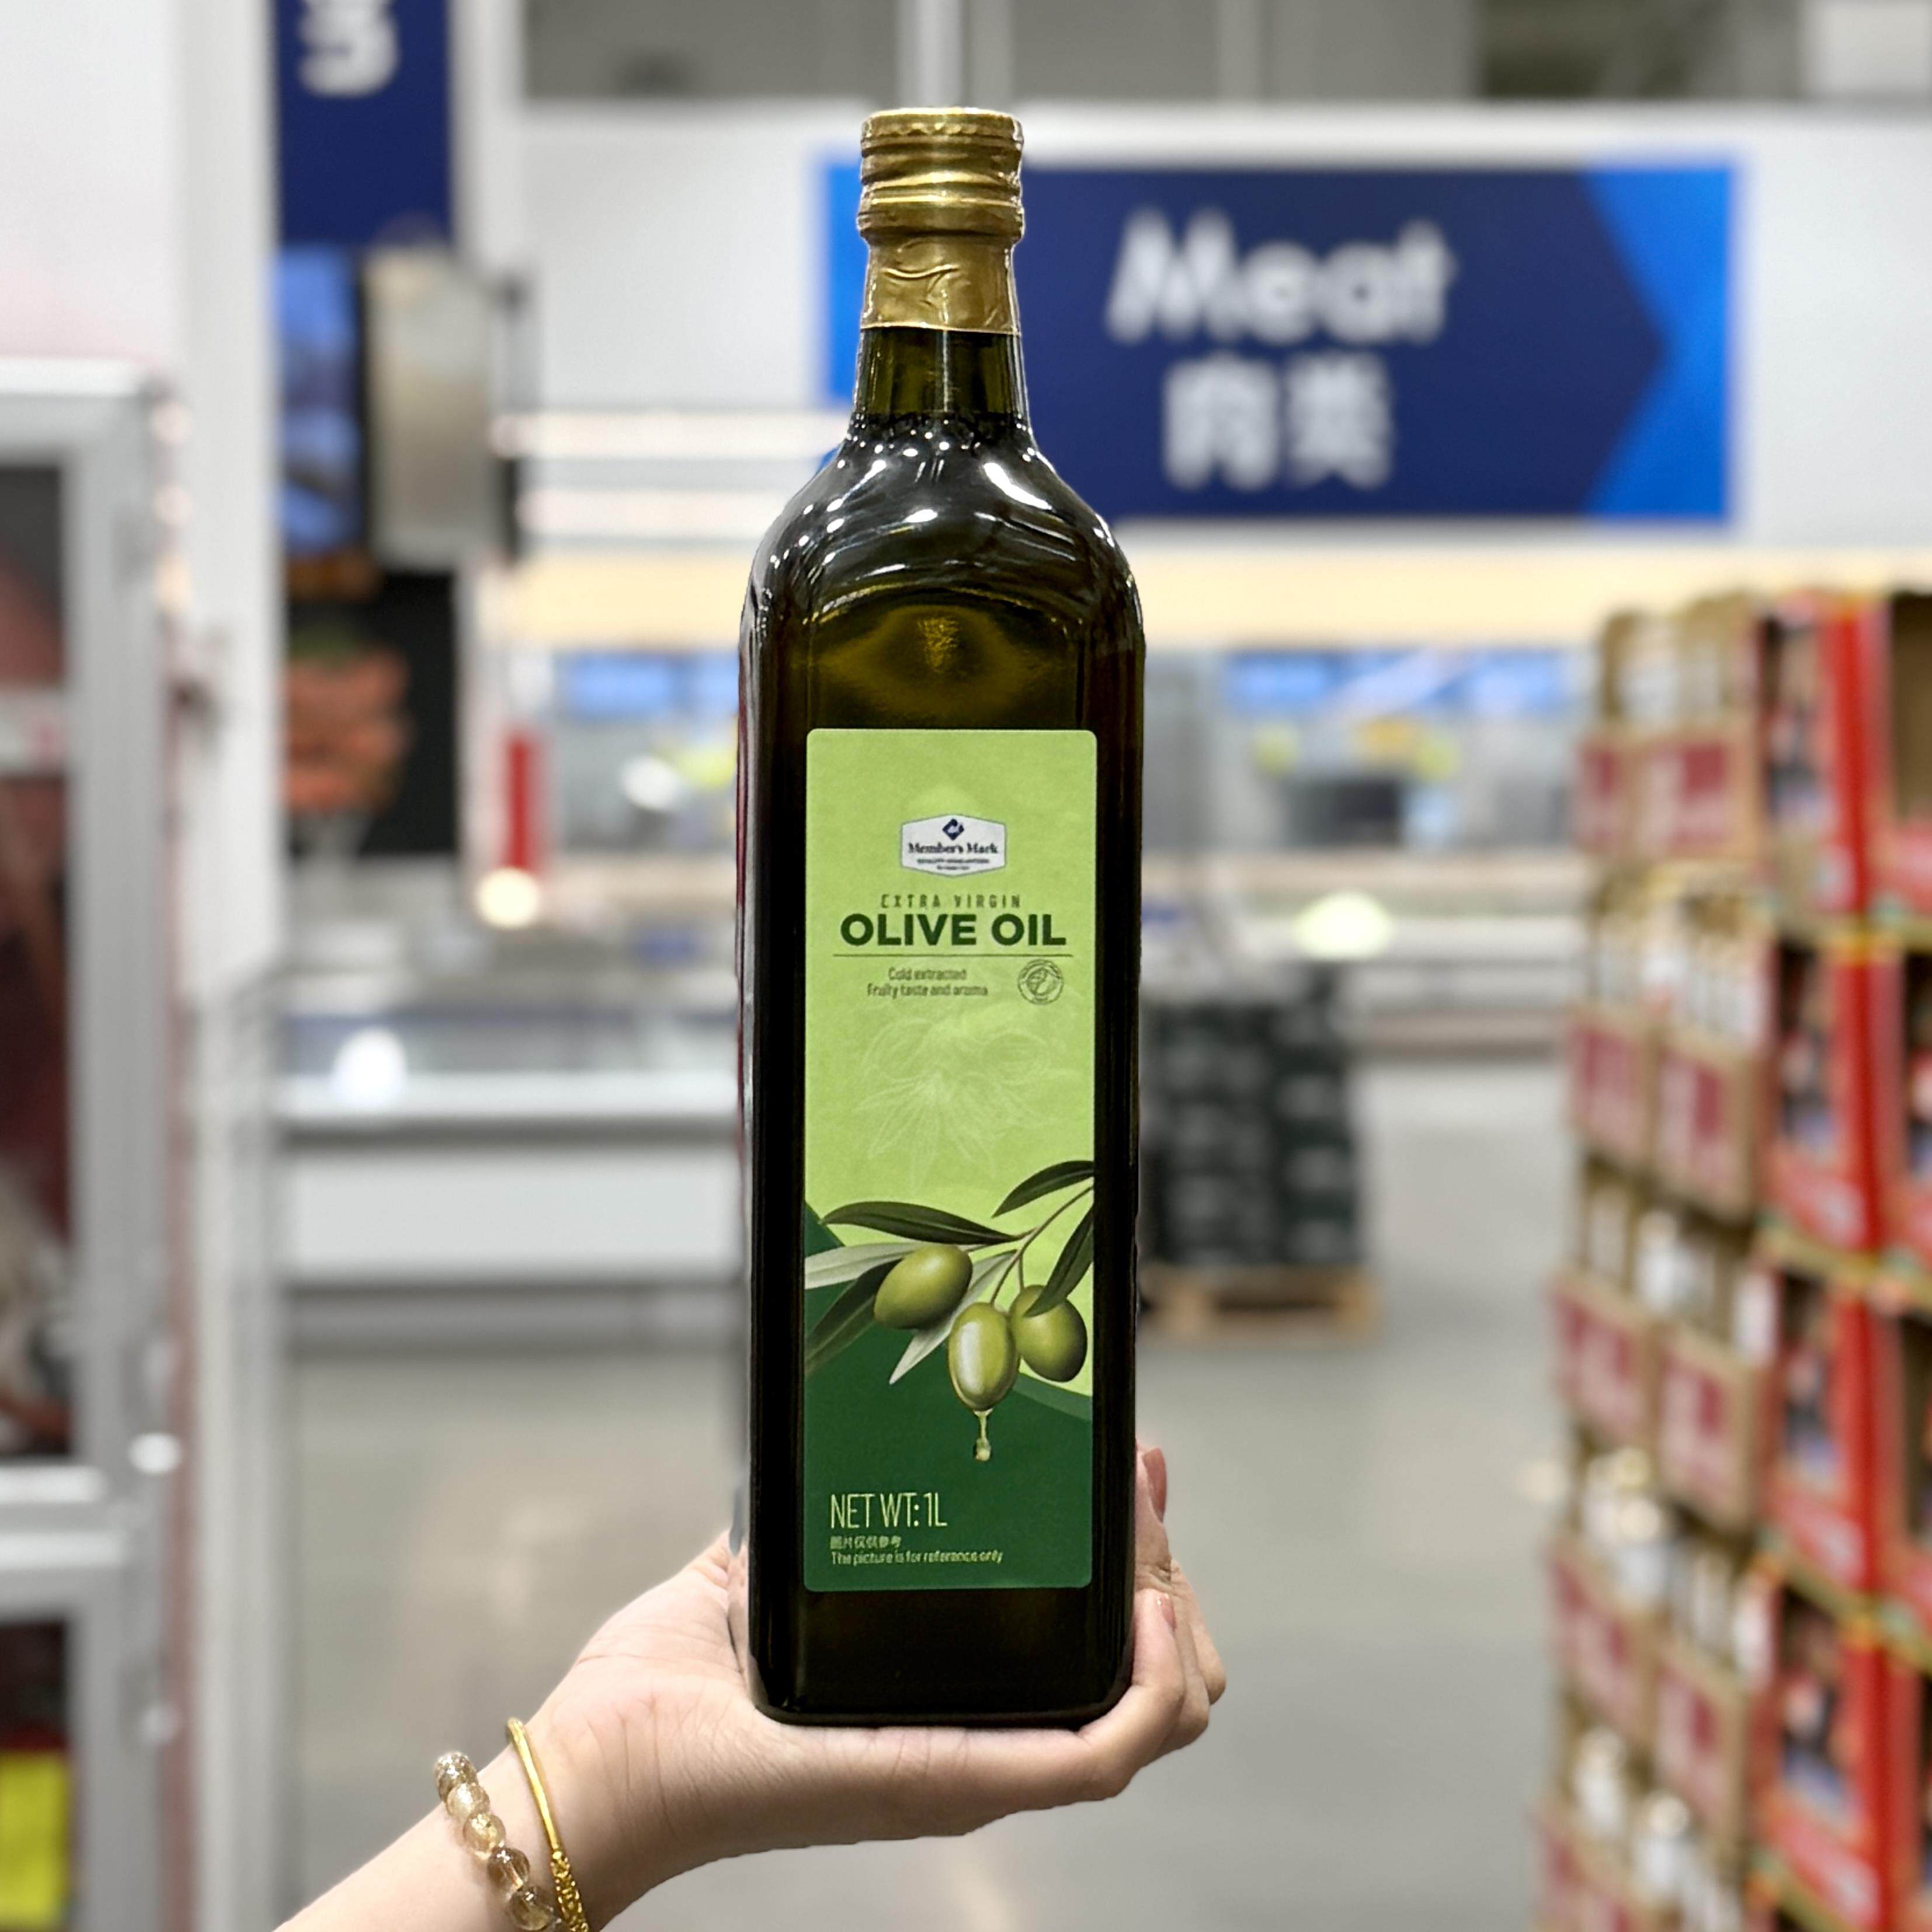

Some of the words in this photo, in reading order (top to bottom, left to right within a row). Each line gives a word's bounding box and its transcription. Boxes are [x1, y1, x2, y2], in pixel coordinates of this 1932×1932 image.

[1108, 211, 1453, 341] Meat
[909, 842, 964, 853] Member's
[967, 842, 999, 853] Mark
[881, 894, 941, 908] EXTRA
[954, 894, 1020, 908] VIRGIN
[840, 913, 977, 946] OLIVE
[991, 913, 1066, 946] OIL
[888, 967, 912, 981] Cold
[867, 982, 898, 999] Fruity
[901, 984, 929, 996] taste
[930, 983, 951, 996] and
[831, 1493, 875, 1528] NET
[831, 1551, 852, 1565] The
[853, 1551, 893, 1566] picture
[894, 1550, 905, 1562] is
[906, 1551, 922, 1563] for
[924, 1550, 978, 1562] reference
[979, 1550, 1003, 1563] only
